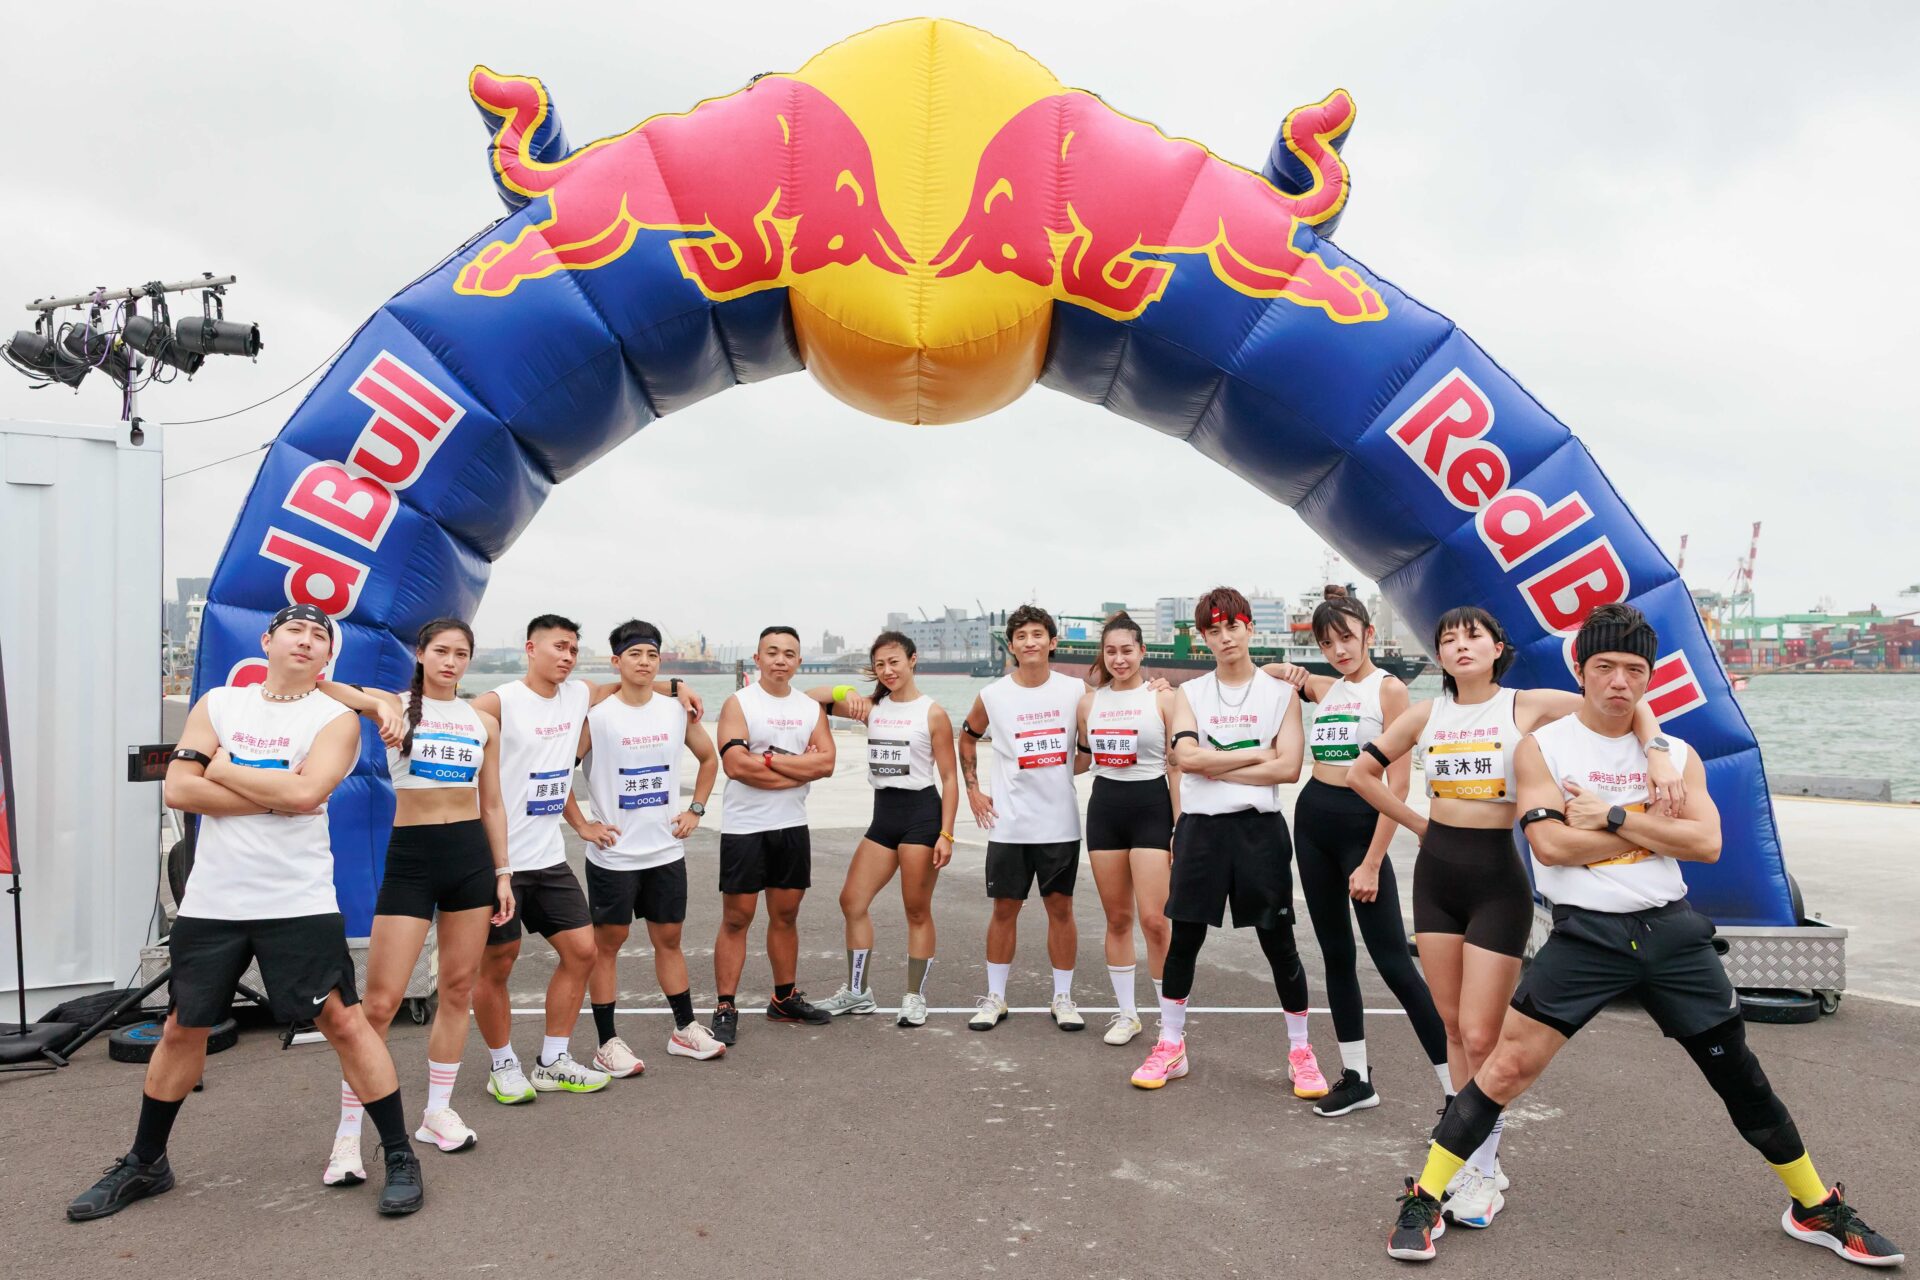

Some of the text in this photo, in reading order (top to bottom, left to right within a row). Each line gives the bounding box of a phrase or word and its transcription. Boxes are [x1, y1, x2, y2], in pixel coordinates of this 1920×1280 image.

[286, 353, 460, 546] Bull
[1392, 373, 1590, 567] Red
[1315, 726, 1349, 741] 艾莉兒
[421, 743, 473, 762] 林佳祐
[1023, 738, 1061, 753] 史博比
[1324, 749, 1350, 757] 0004
[1037, 756, 1062, 765] 0004
[1107, 757, 1129, 765] 0004
[1434, 757, 1493, 776] 黃沐妍
[435, 769, 467, 779] 0004
[1455, 785, 1493, 795] 0004
[637, 796, 662, 806] 0004
[537, 1069, 587, 1087] HYROX
